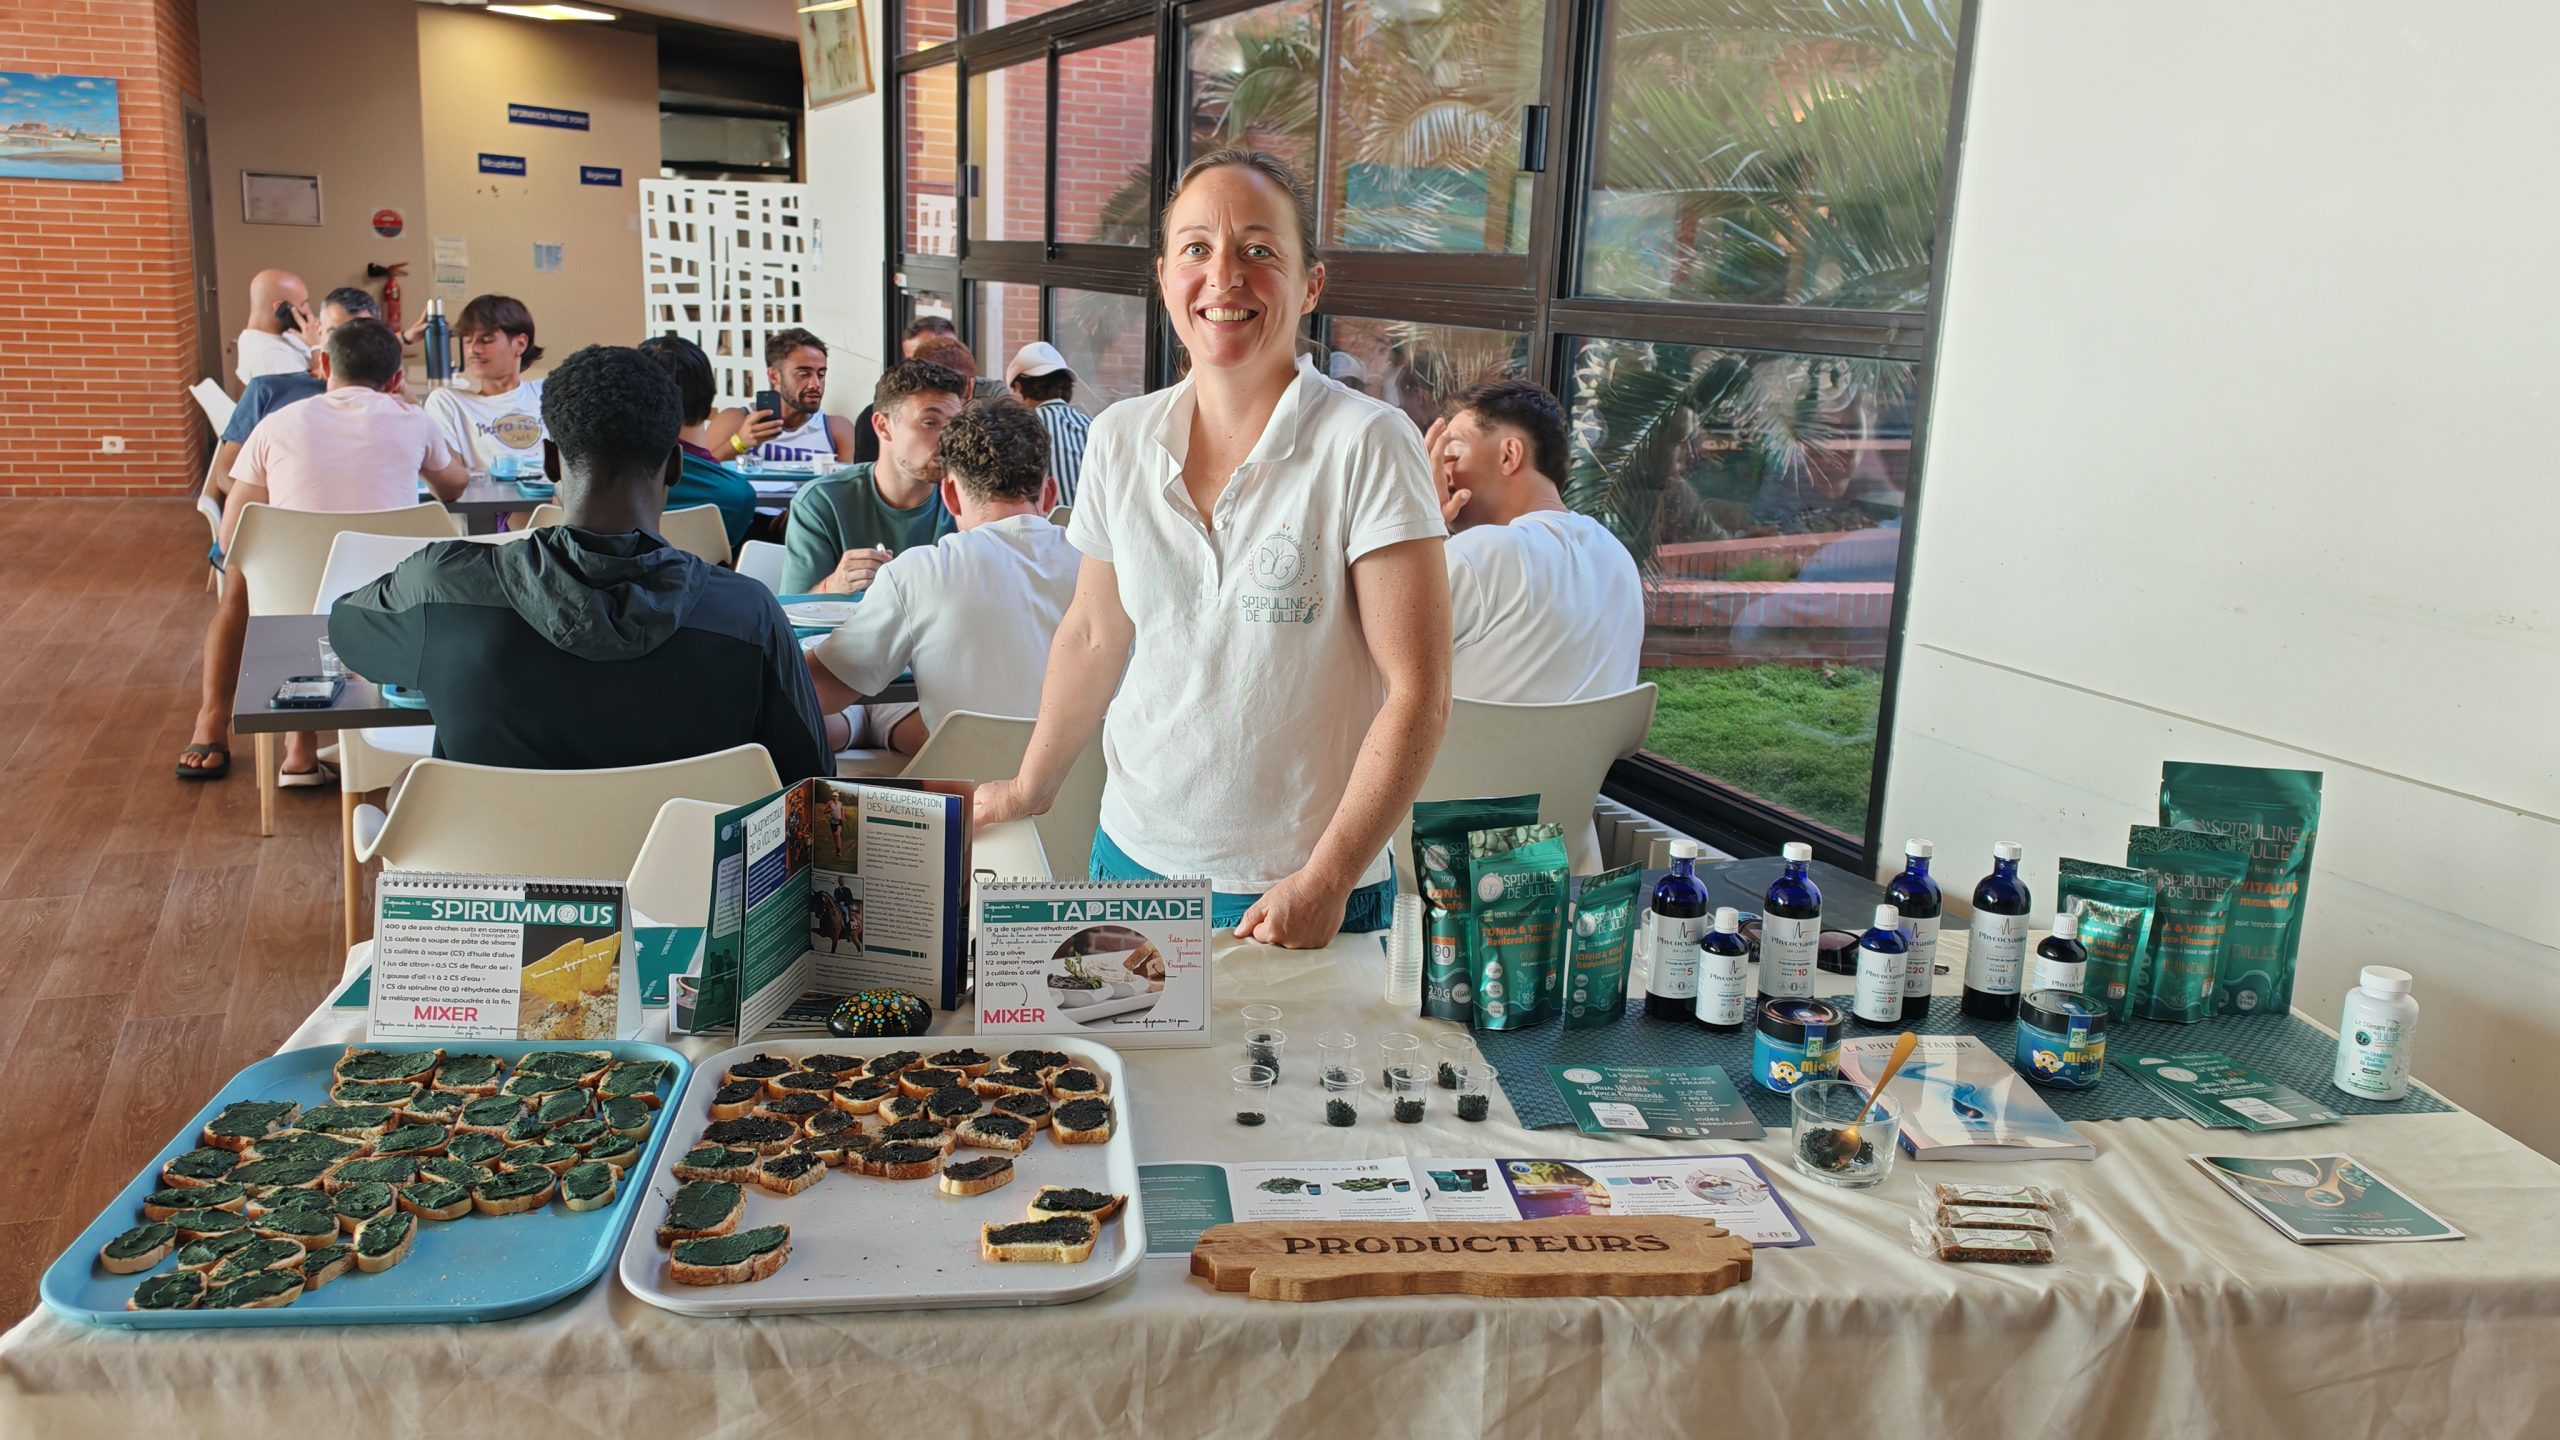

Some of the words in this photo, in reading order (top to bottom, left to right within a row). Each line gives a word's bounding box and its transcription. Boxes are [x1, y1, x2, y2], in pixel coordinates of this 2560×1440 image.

[1242, 595, 1306, 610] SPIRULINE
[1246, 610, 1260, 622] DE
[1266, 610, 1304, 623] JULIE
[867, 792, 879, 800] LA
[867, 802, 882, 812] DES
[885, 805, 925, 817] LACTATES
[2211, 820, 2300, 843] SPIRULINE
[1504, 870, 1558, 887] SPIRULINE
[2164, 872, 2229, 889] SPIRULINE
[1507, 888, 1520, 899] DE
[1525, 885, 1555, 897] JULIE
[2168, 886, 2183, 898] DE
[2188, 888, 2224, 901] JULIE
[431, 899, 613, 925] SPIRUMMOUS
[1047, 900, 1202, 921] TAPENADE
[1435, 945, 1450, 958] 90
[1686, 967, 1694, 976] 5
[1797, 968, 1808, 977] 10
[442, 997, 483, 1005] saupoudrée
[414, 1005, 478, 1022] MIXER
[983, 1008, 1045, 1024] MIXER
[1868, 1041, 1976, 1050] PHYCYANINE
[1282, 1234, 1672, 1255] PRODUCTEURS
